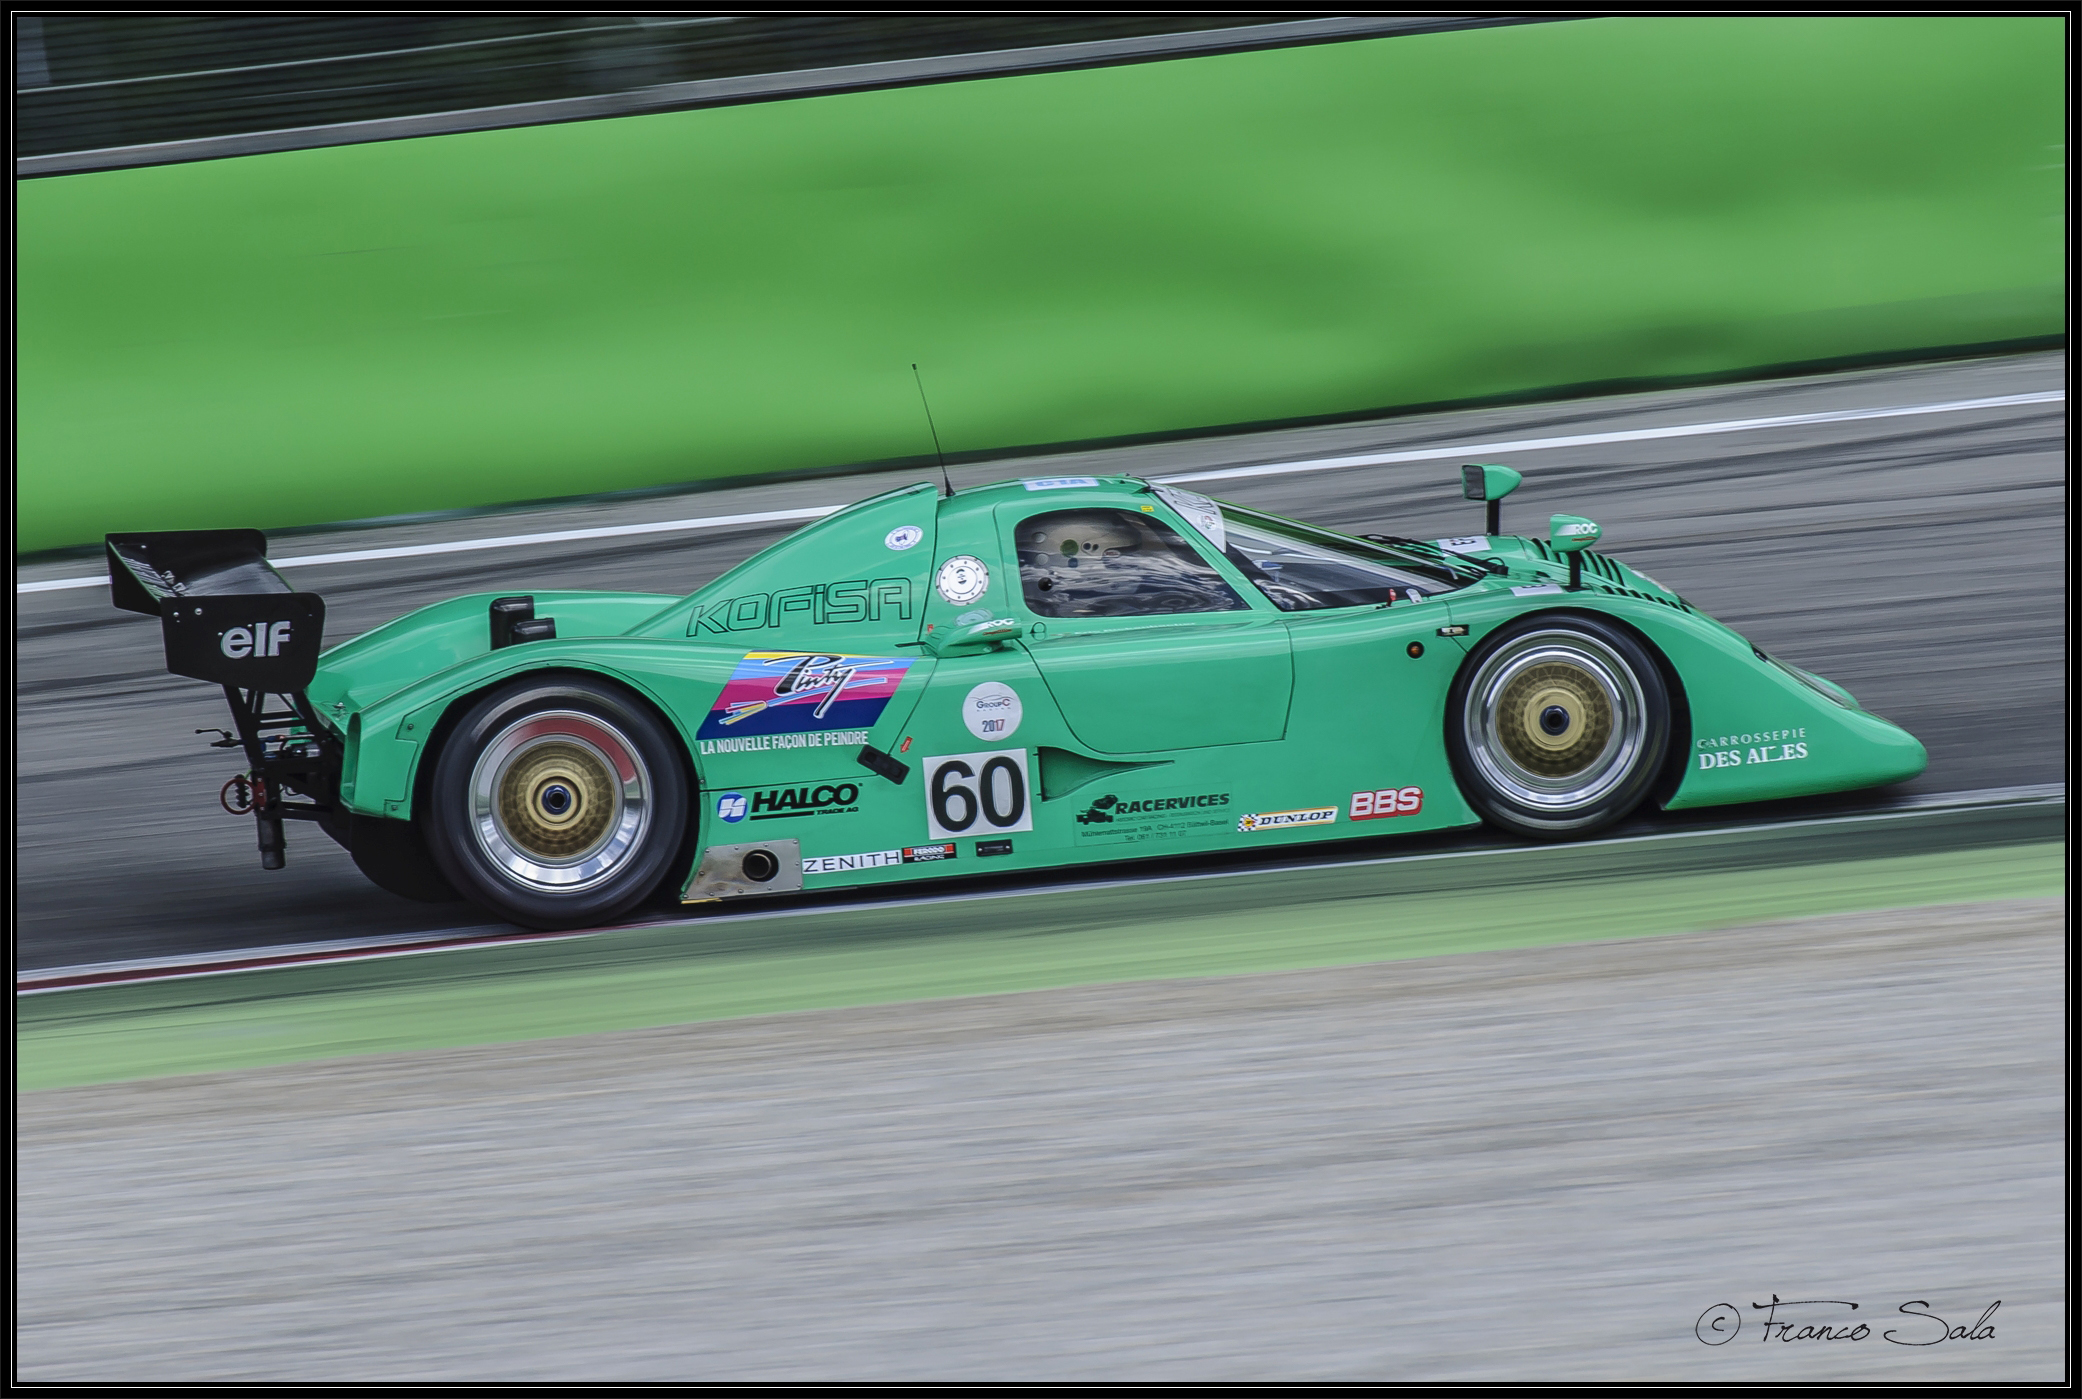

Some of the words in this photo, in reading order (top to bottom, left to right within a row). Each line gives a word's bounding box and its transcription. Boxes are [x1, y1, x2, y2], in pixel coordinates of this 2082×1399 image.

[220, 620, 291, 660] elf
[981, 718, 1006, 733] 2017
[700, 740, 716, 755] LA
[717, 736, 772, 753] NOUVELLE
[772, 733, 807, 750] FAÇON
[808, 732, 823, 747] DE
[824, 730, 869, 746] PEINDRE
[1698, 749, 1742, 770] DES
[751, 782, 860, 813] HALCO
[931, 755, 1026, 833] 60
[1115, 792, 1230, 815] RACERVICES
[1349, 786, 1423, 821] BBS
[1258, 810, 1336, 826] DUNLOP
[803, 852, 901, 872] ZENITH
